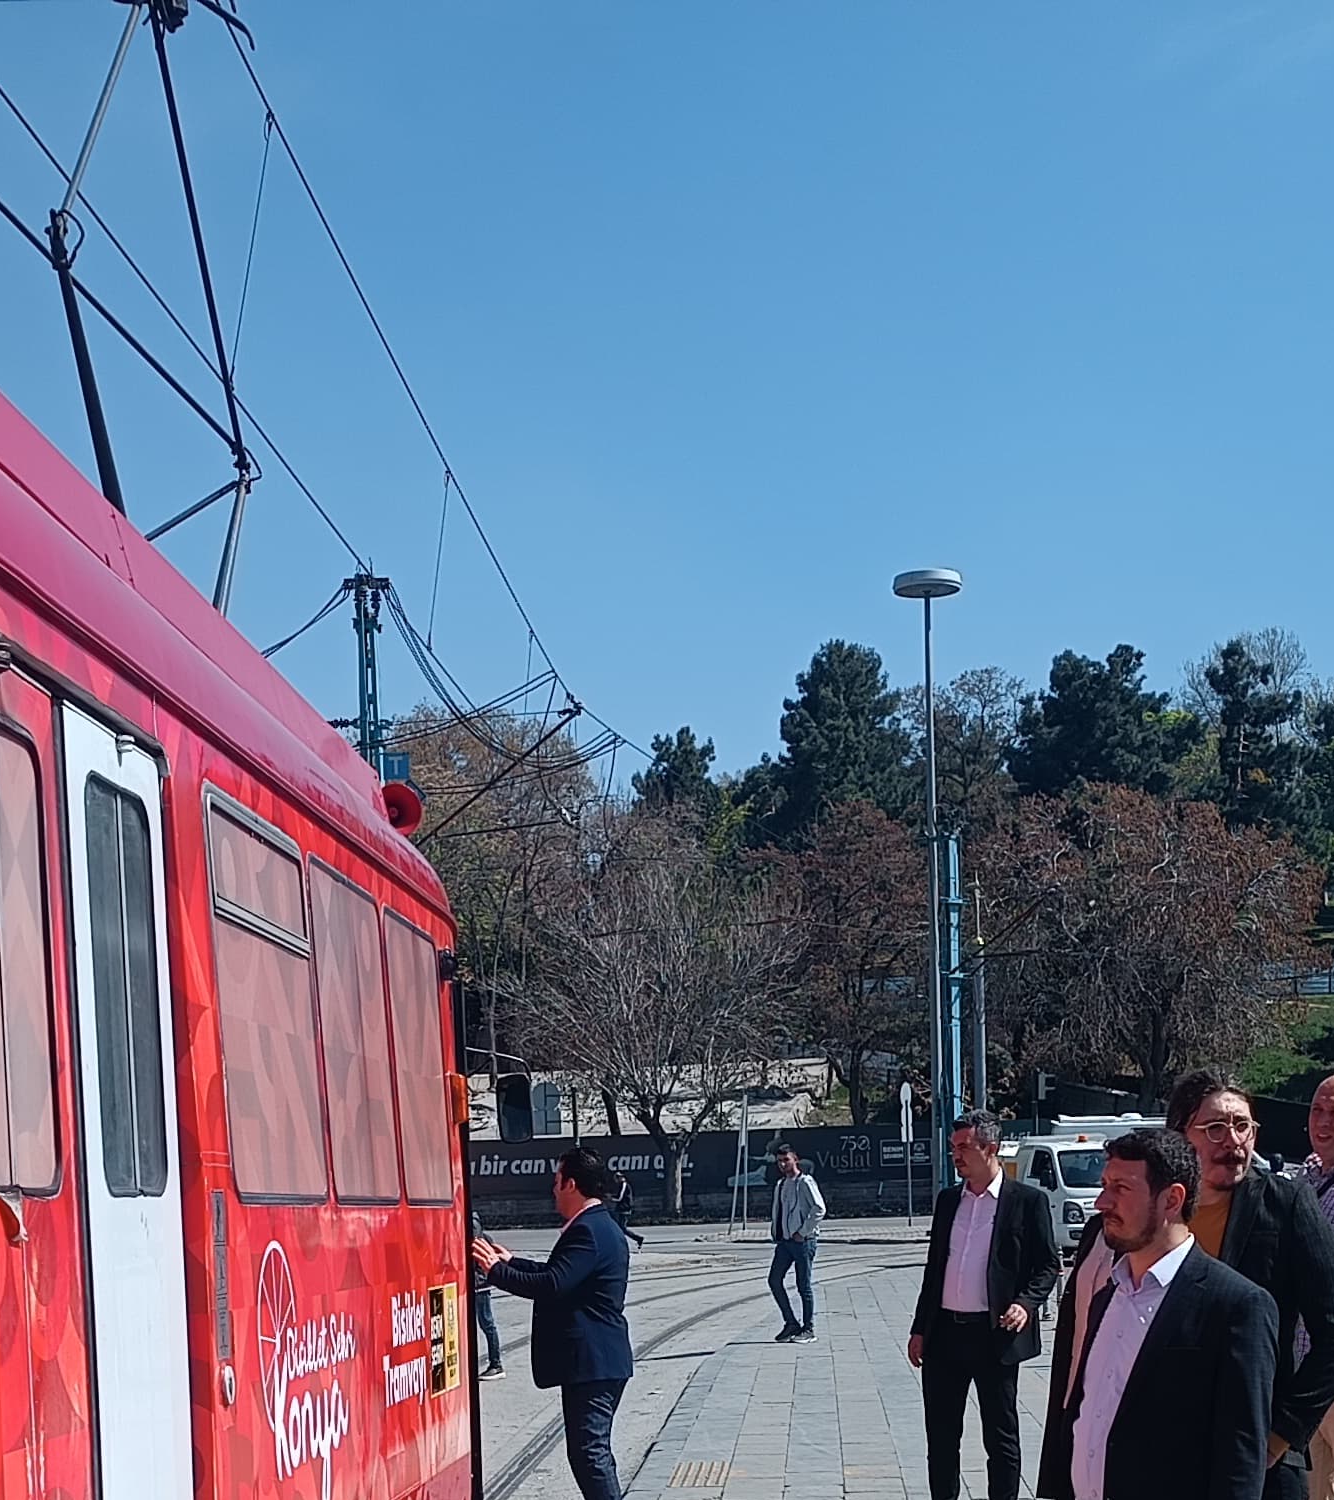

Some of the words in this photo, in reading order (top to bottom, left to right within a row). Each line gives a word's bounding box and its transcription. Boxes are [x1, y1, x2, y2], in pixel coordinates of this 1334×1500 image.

[479, 1155, 507, 1176] bir
[511, 1159, 546, 1174] can
[608, 1155, 650, 1171] canı
[286, 1315, 328, 1380] Bisiklet
[391, 1289, 426, 1348] Bisiklet
